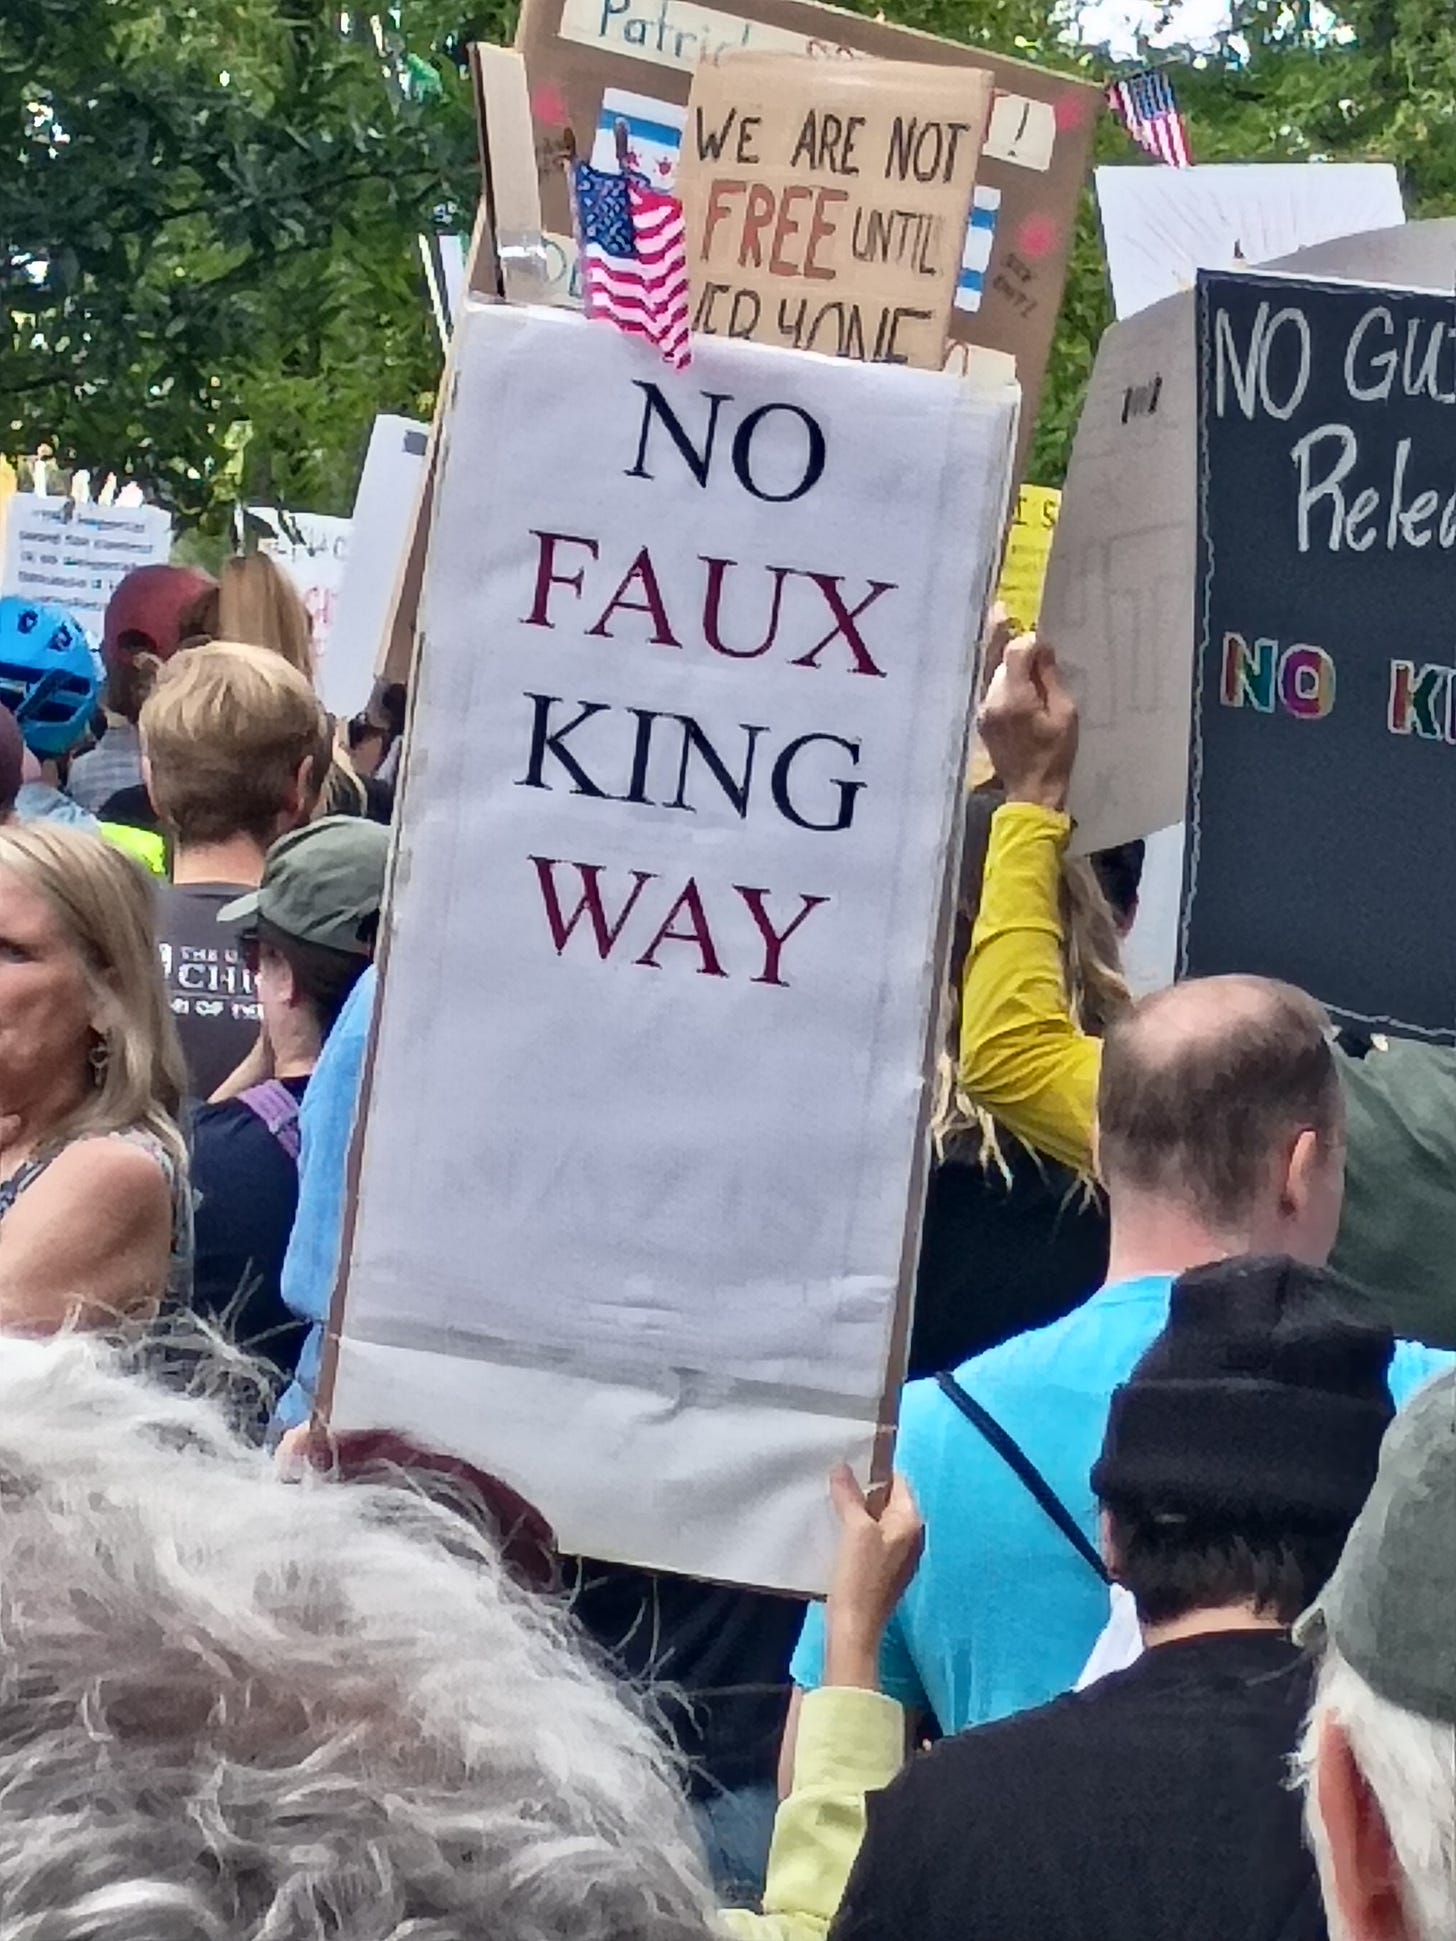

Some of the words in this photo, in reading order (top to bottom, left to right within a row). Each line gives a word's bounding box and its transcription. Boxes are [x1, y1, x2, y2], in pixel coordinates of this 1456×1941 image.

[696, 106, 762, 164] WE
[790, 109, 866, 177] ARE
[884, 116, 971, 184] NOT
[700, 178, 849, 280] FREE
[852, 205, 938, 277] UNTIL
[1215, 301, 1311, 421] NO
[622, 379, 827, 503] NO
[518, 528, 899, 678] FAUX
[1220, 631, 1337, 720] NO
[513, 691, 868, 832] KING
[526, 853, 832, 988] WAY
